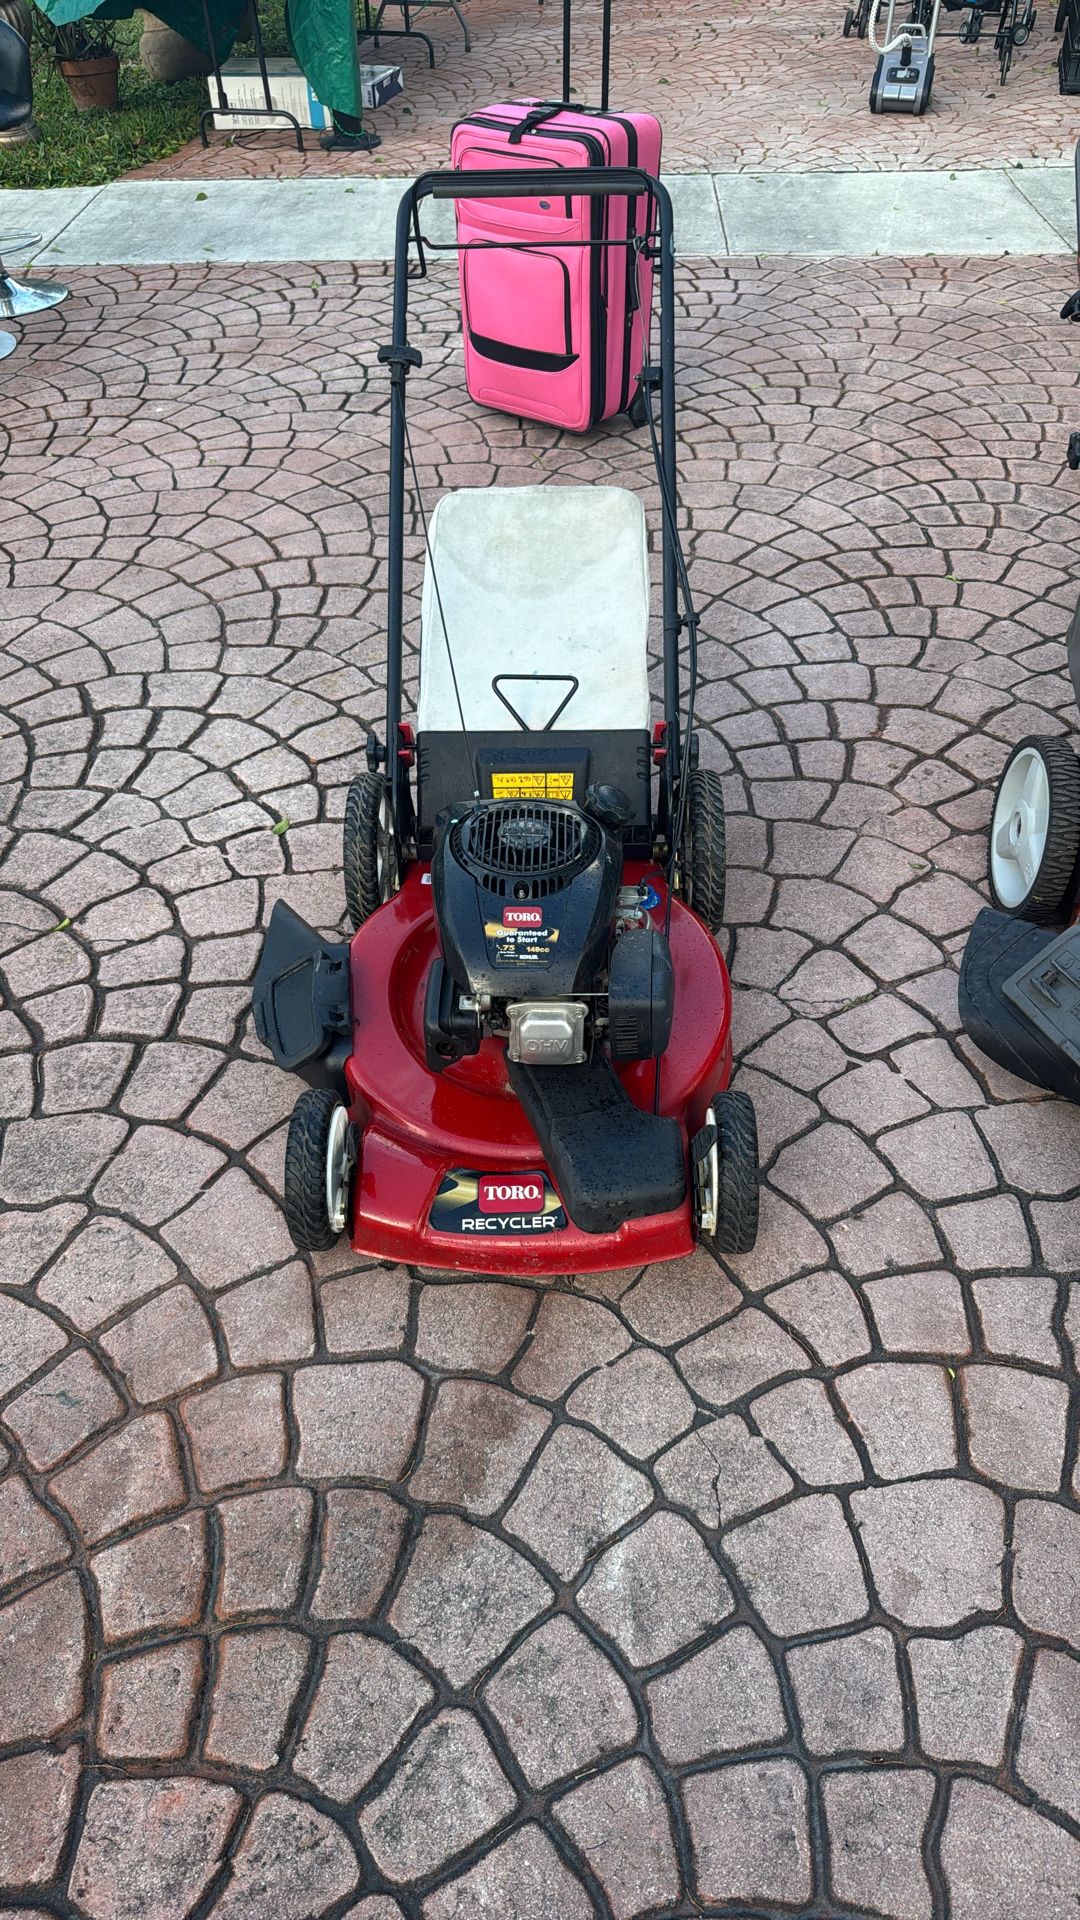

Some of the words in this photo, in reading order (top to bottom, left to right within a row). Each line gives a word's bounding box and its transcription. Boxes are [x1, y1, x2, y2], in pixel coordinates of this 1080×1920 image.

[506, 912, 541, 922] TORO
[496, 929, 548, 937] Guaranteed
[526, 1040, 569, 1053] OHV
[484, 1184, 541, 1200] TORO
[461, 1216, 558, 1230] RECYCLER
